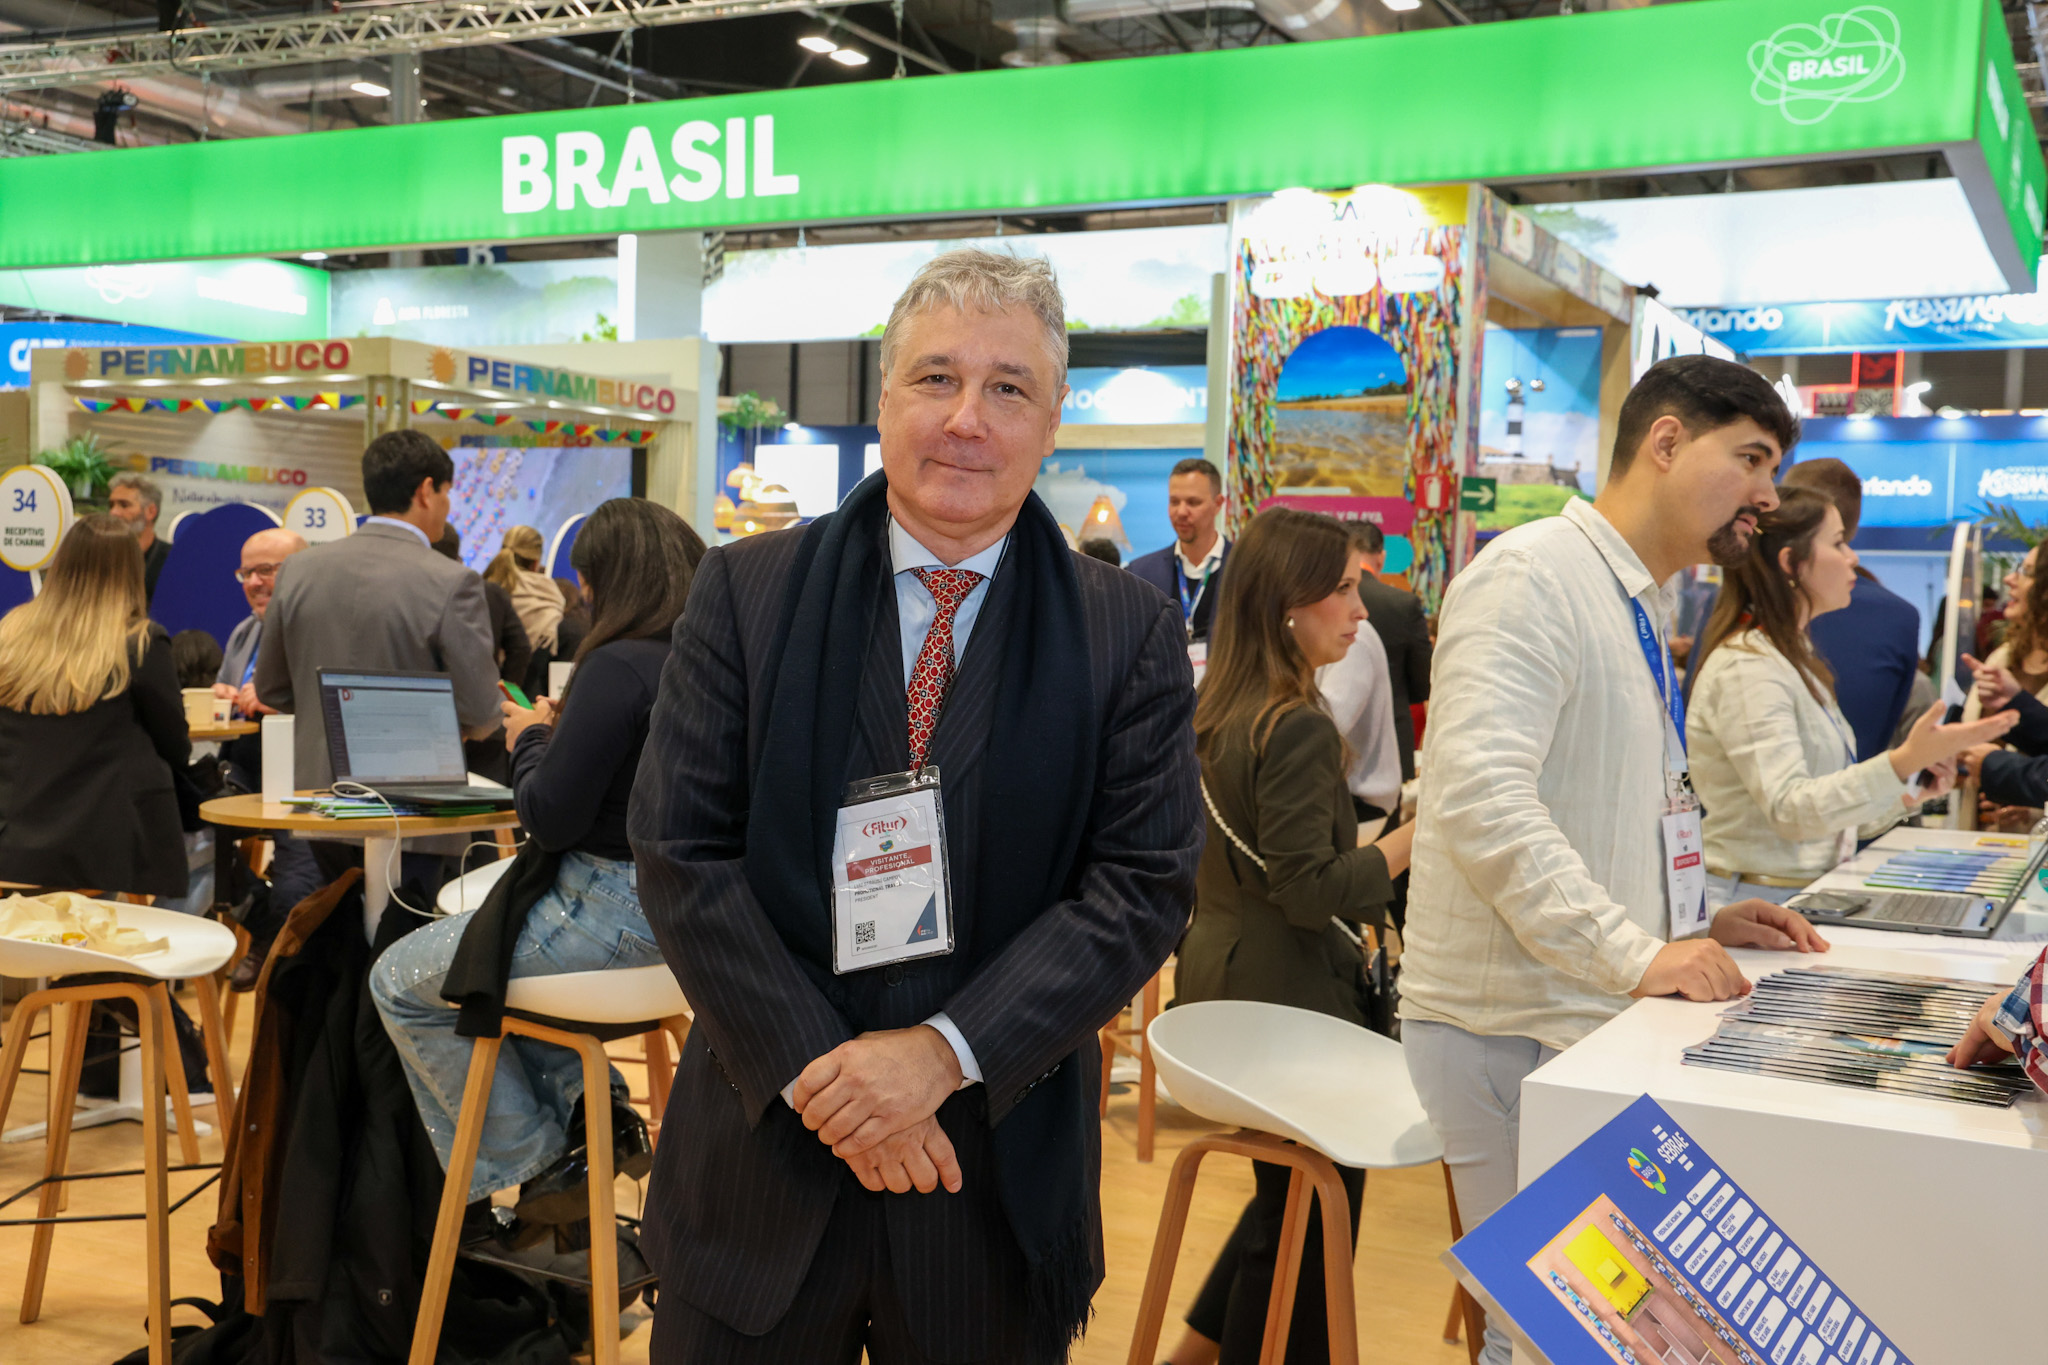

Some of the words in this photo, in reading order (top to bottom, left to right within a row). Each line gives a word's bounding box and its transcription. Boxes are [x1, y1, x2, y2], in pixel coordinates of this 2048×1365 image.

[1787, 54, 1869, 81] BRASIL
[502, 115, 799, 214] BRASIL
[101, 343, 349, 375] PERNAMBUCO
[468, 355, 676, 414] PERNAMBUCO
[151, 456, 307, 486] PERNAMBUCO
[12, 488, 38, 513] 34
[305, 507, 327, 528] 33
[864, 858, 916, 875] PROFESIONAL
[870, 852, 909, 866] VISITANTE
[1656, 1131, 1689, 1164] SEBRAE
[1719, 1329, 1729, 1340] 22
[1741, 1351, 1750, 1363] 23
